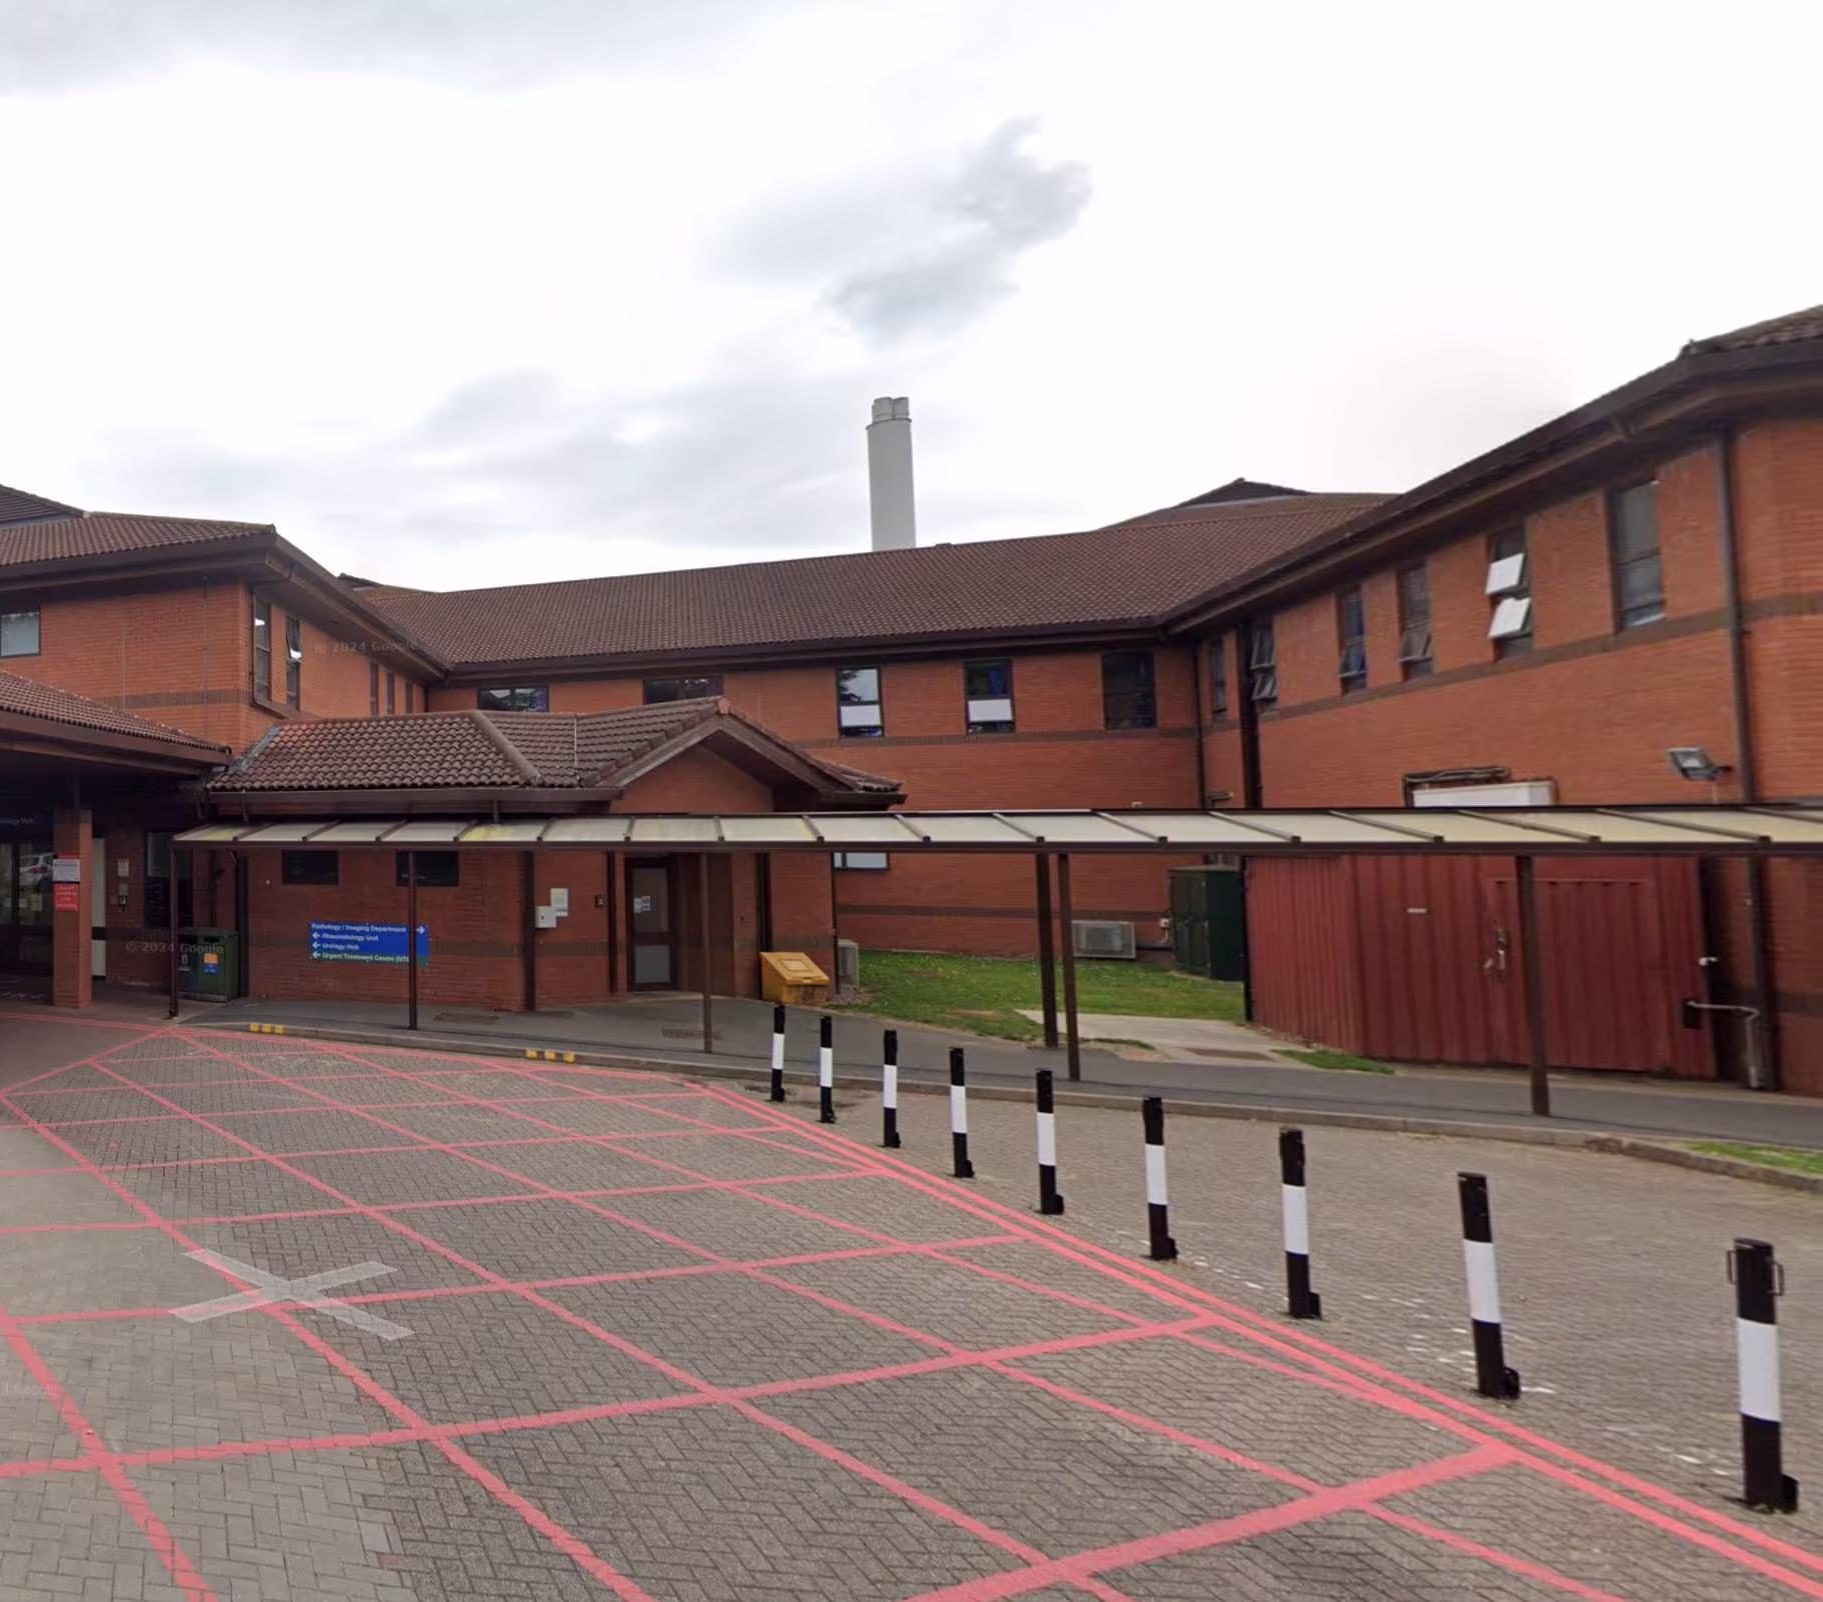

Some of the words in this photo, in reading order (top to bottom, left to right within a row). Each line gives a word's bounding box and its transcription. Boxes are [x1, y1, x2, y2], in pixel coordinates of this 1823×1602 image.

[312, 923, 341, 932] Radiology
[345, 924, 370, 932] Imaging
[370, 925, 407, 933] Department
[322, 933, 365, 941] Rheumatology
[322, 943, 345, 951] Urology
[322, 952, 343, 961] Urgent
[343, 953, 373, 961] Treatment
[374, 954, 394, 962] Centre
